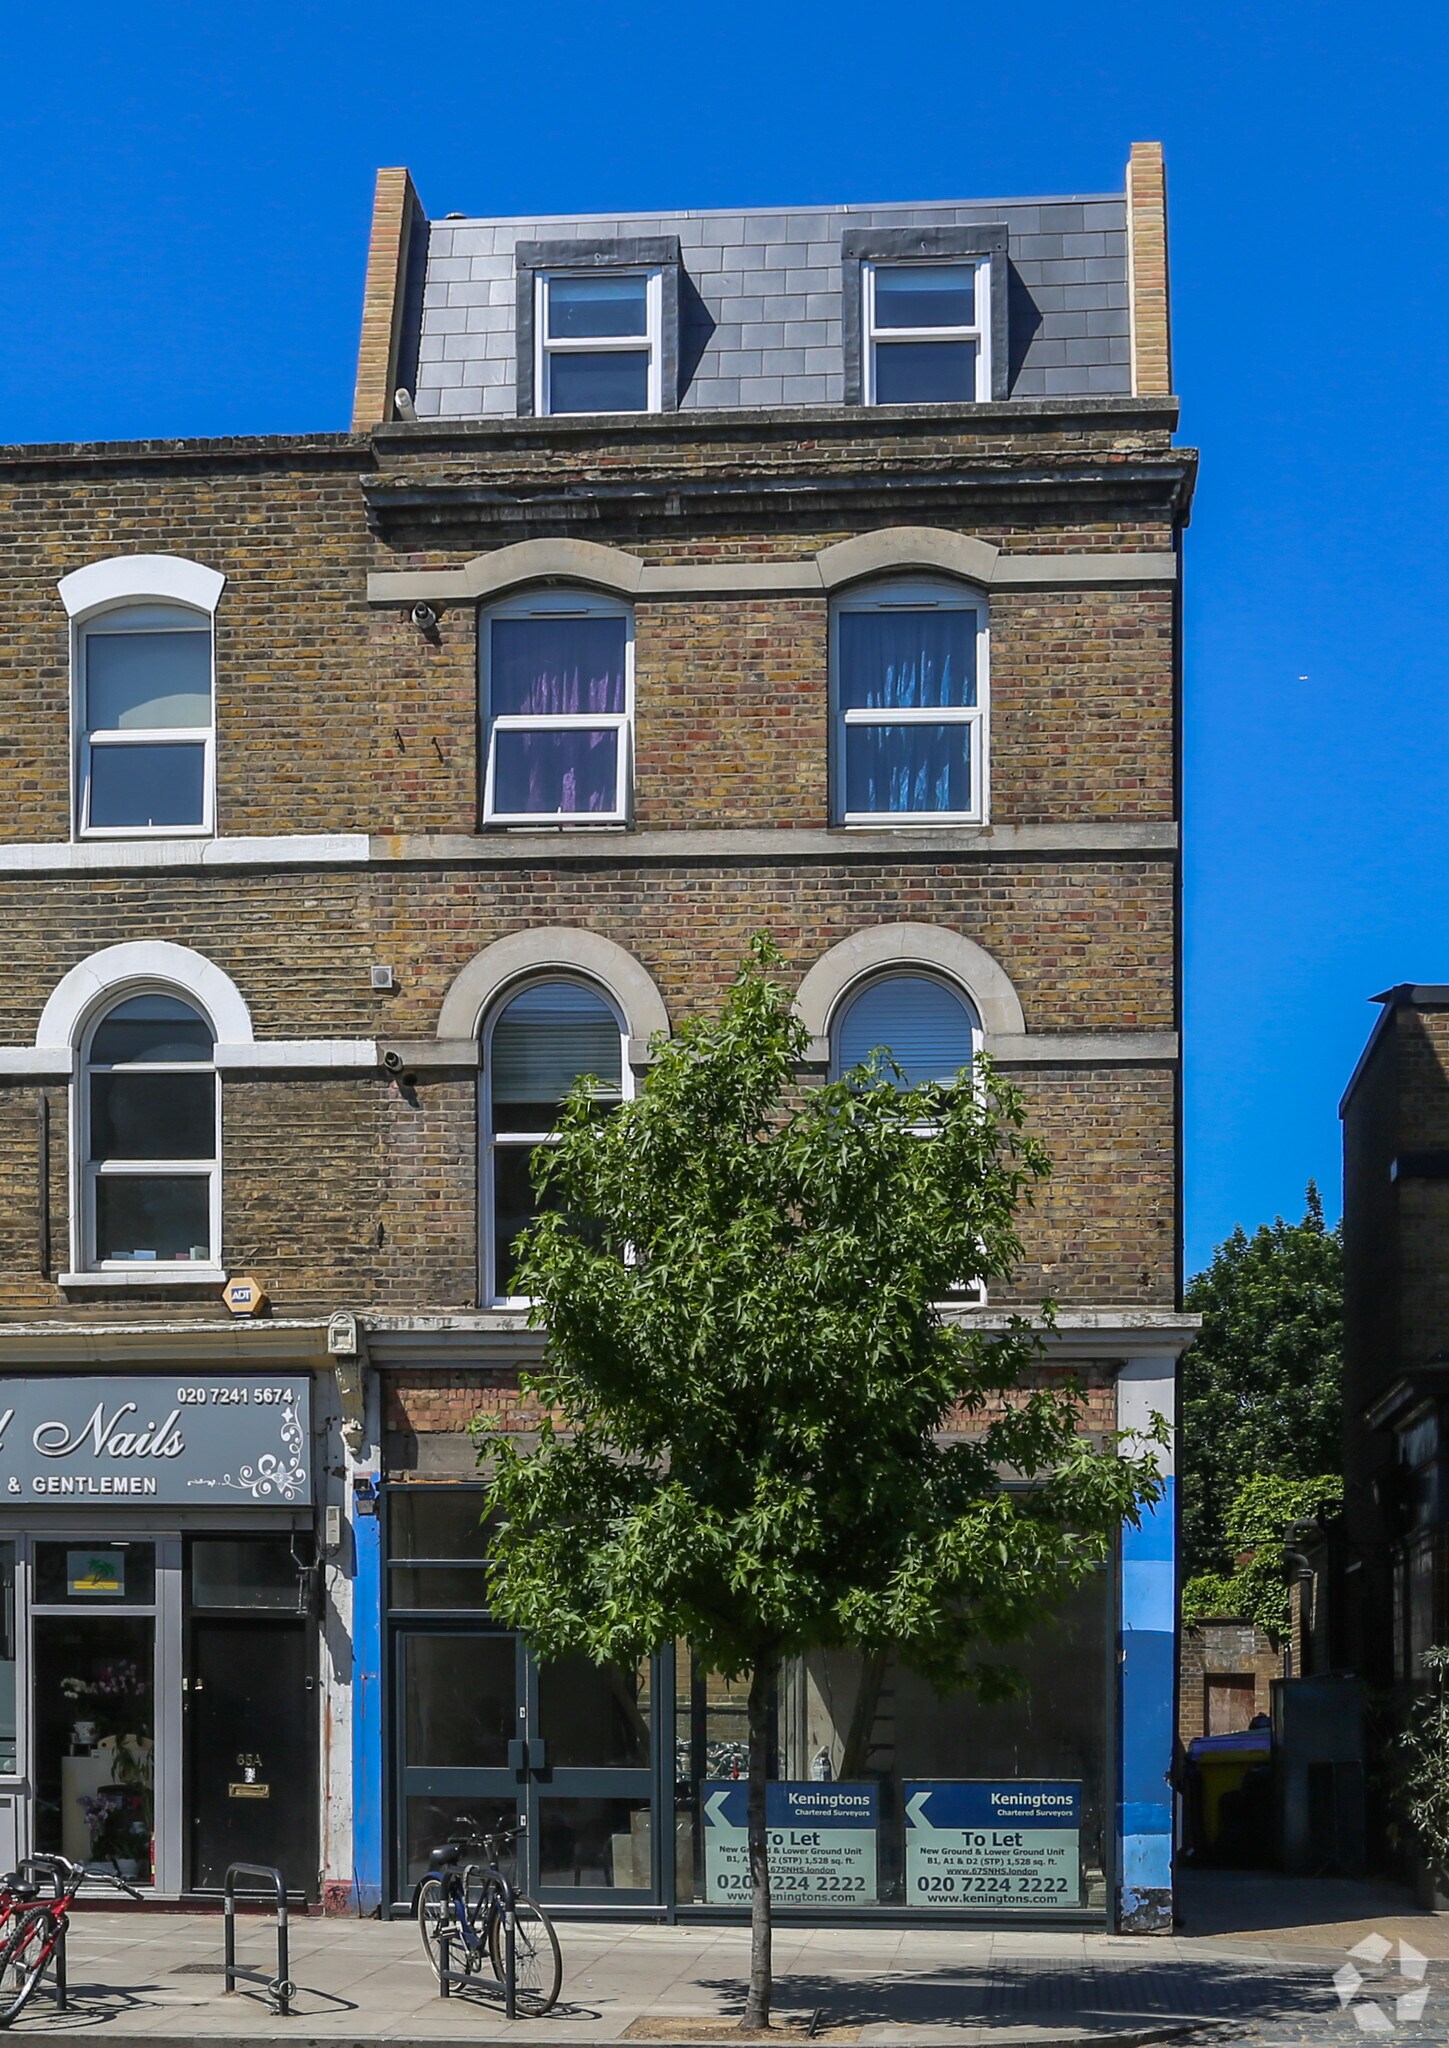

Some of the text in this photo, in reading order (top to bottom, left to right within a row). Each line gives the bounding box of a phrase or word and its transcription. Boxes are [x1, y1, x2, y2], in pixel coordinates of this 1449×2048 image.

[232, 1290, 250, 1300] ADT
[177, 1388, 292, 1403] 020 7241 5674
[33, 1402, 185, 1457] Nails
[8, 1477, 156, 1494] & GENTLEMEN
[236, 1754, 262, 1766] 65A
[788, 1793, 870, 1807] Keningtons
[991, 1793, 1073, 1807] Keningtons
[791, 1832, 820, 1845] Let
[962, 1832, 1023, 1846] To Let
[720, 1846, 738, 1854] New
[727, 1856, 740, 1864] B1,
[779, 1857, 802, 1865] (STP)
[805, 1857, 829, 1865] 1,528
[981, 1858, 1004, 1866] (STP)
[1007, 1858, 1031, 1866] 1,528
[717, 1875, 866, 1891] 020 224 2222
[917, 1877, 1068, 1892] 020 7224 2222
[928, 1893, 1058, 1905] www.keningtons.com
